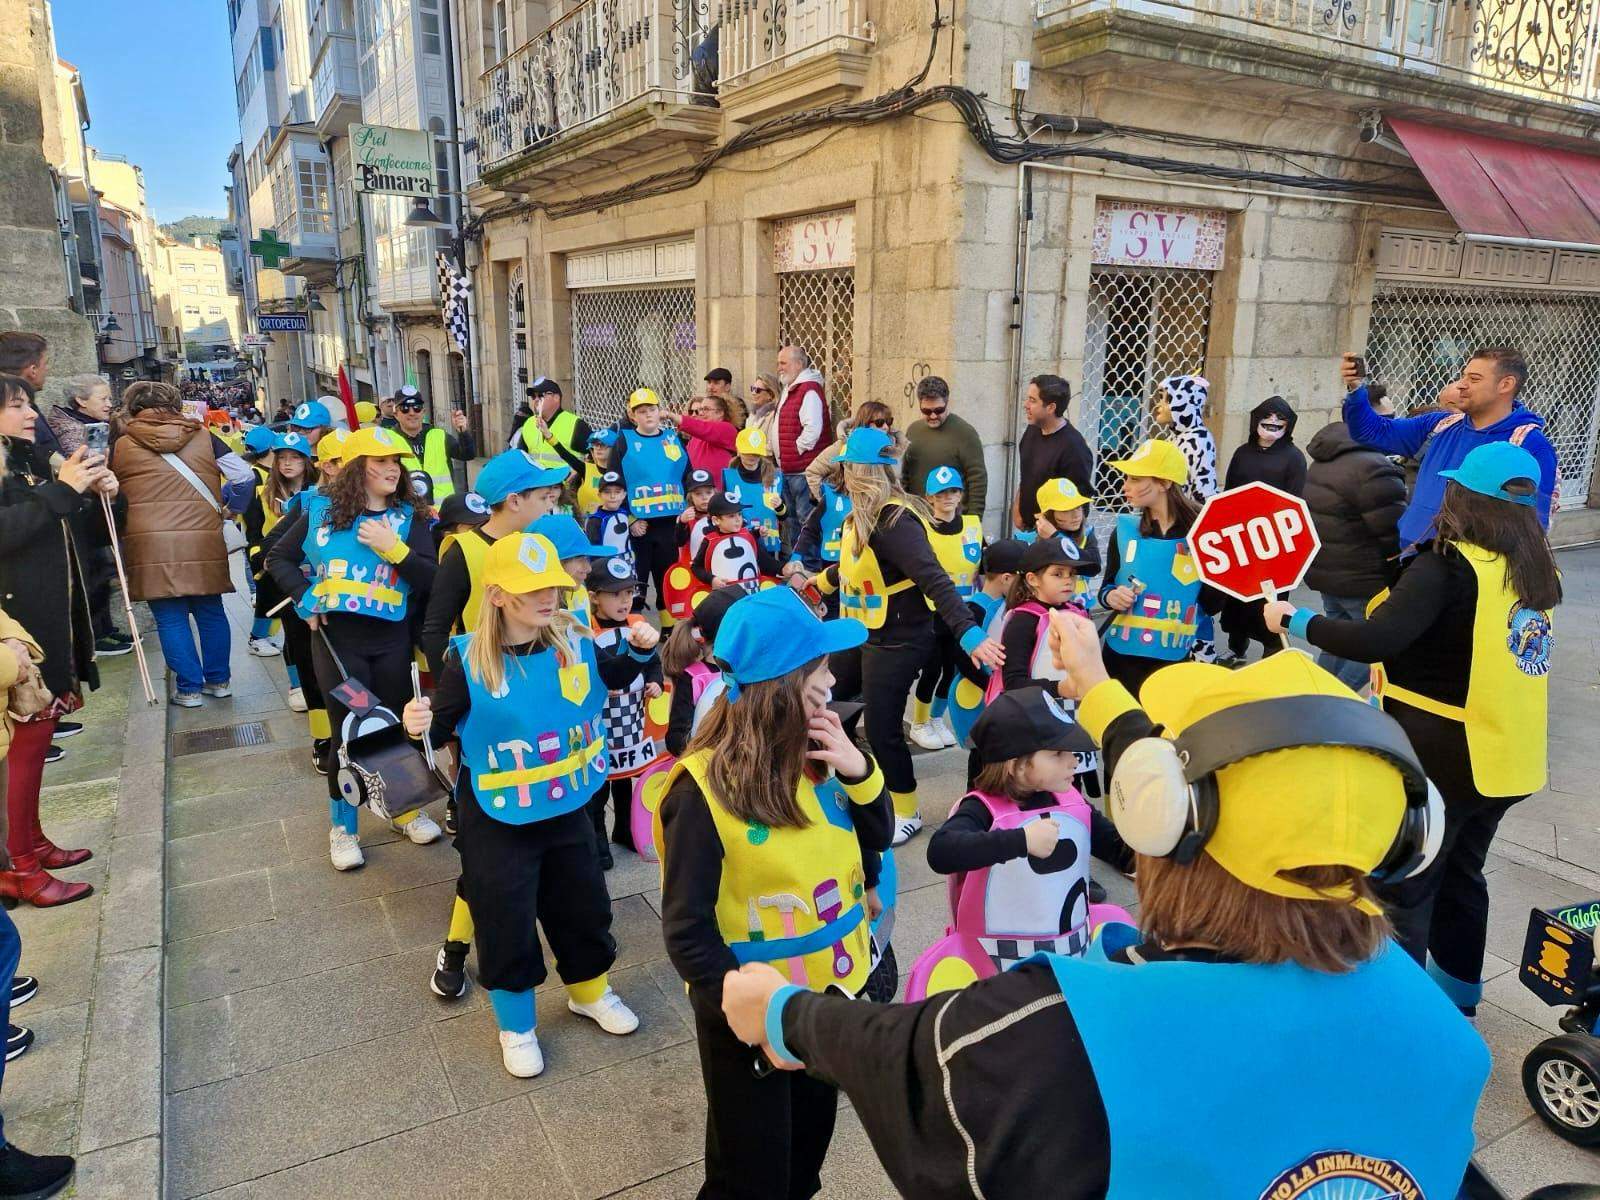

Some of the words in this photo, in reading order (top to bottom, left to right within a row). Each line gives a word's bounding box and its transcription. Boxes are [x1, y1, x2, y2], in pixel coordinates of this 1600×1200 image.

[354, 127, 387, 146] Piel
[357, 164, 430, 192] Tamara
[803, 218, 843, 263] SV
[1125, 212, 1185, 260] SV
[259, 318, 306, 329] ORTOPEDIA
[1199, 509, 1304, 574] STOP
[1290, 1166, 1316, 1187] LA
[1316, 1154, 1419, 1200] INMACULADA
